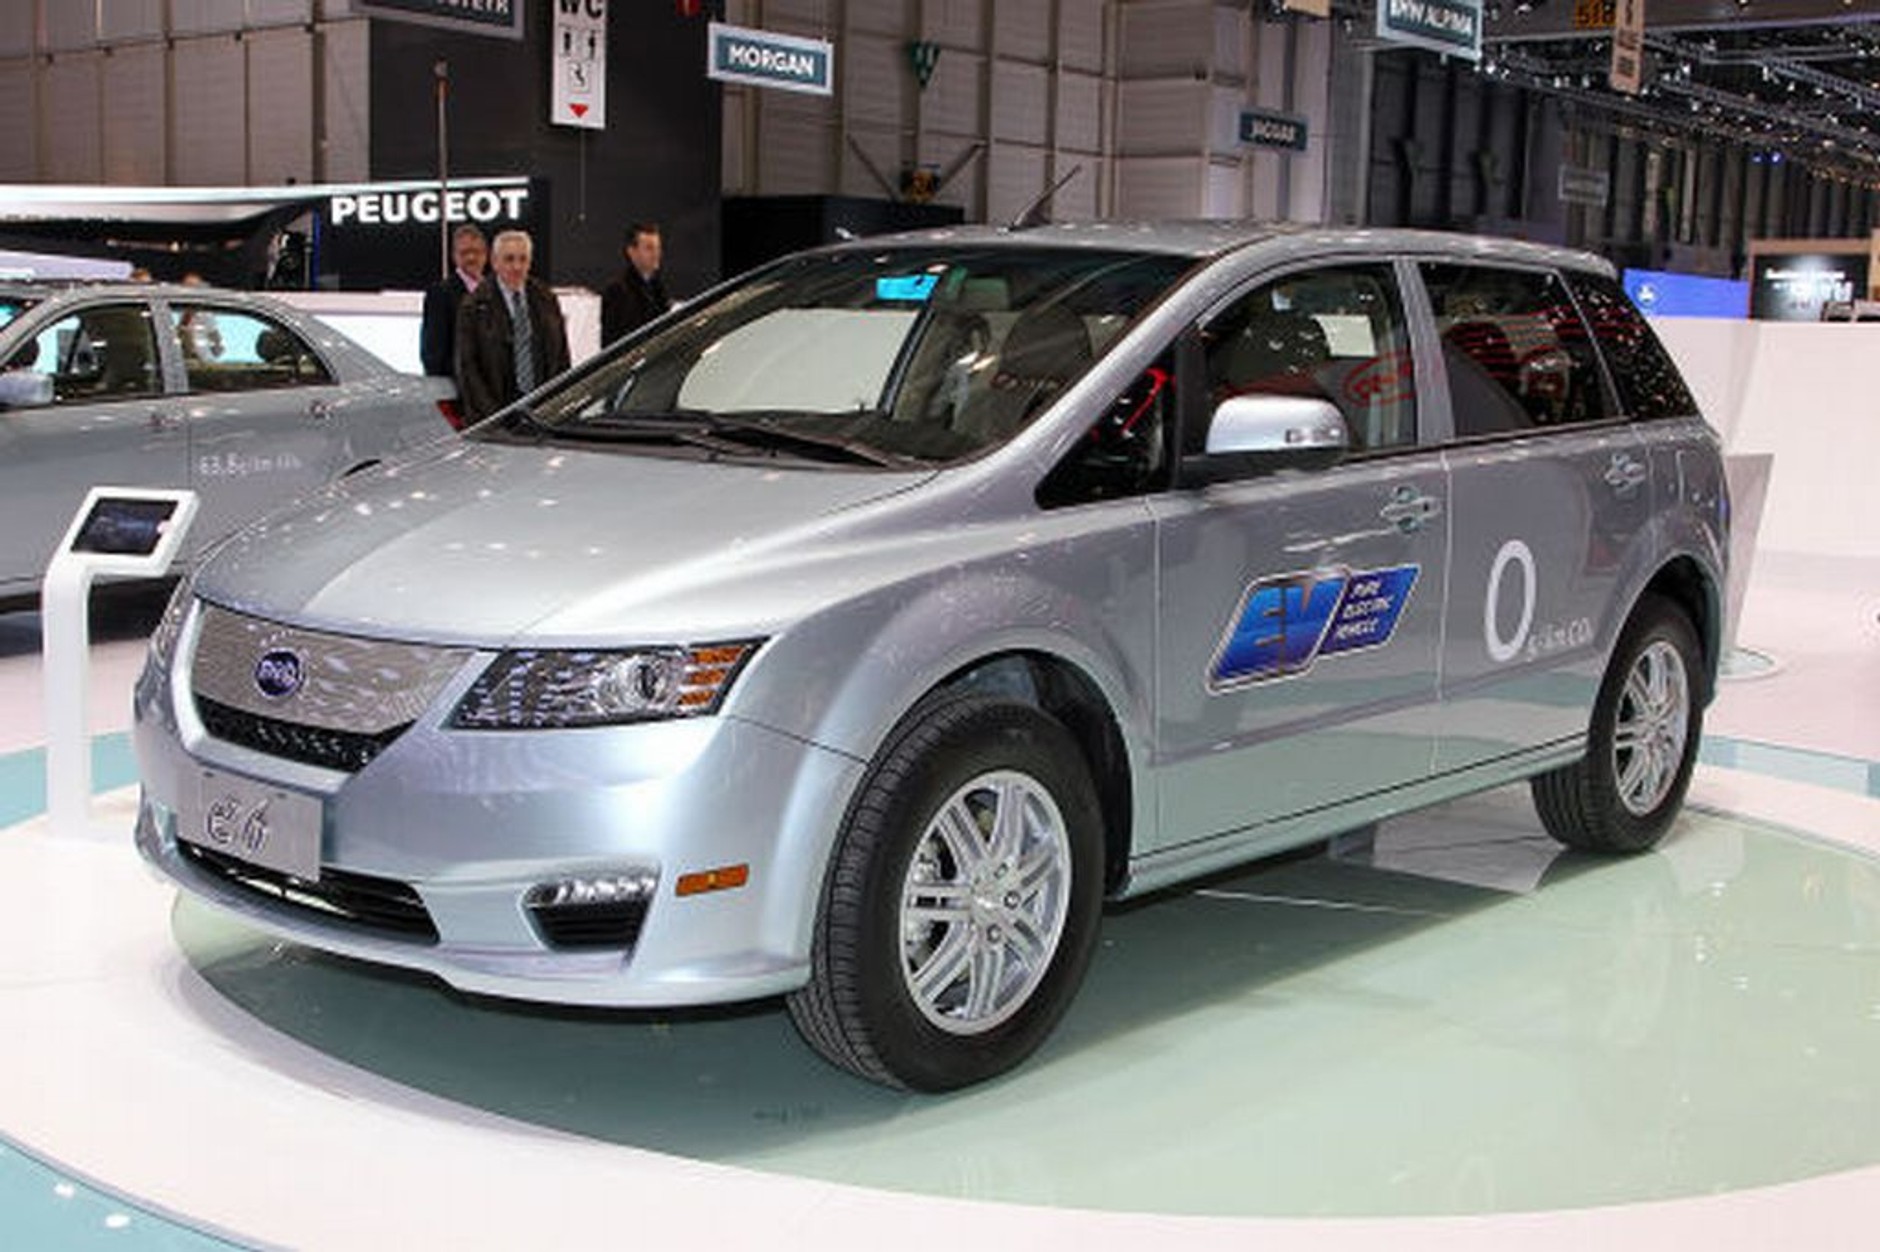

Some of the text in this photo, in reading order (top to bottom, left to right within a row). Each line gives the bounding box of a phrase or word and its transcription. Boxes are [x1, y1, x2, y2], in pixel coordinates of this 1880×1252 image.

[728, 44, 815, 77] MORGAN
[331, 188, 529, 225] PEUGEOT
[1213, 574, 1346, 682] EV
